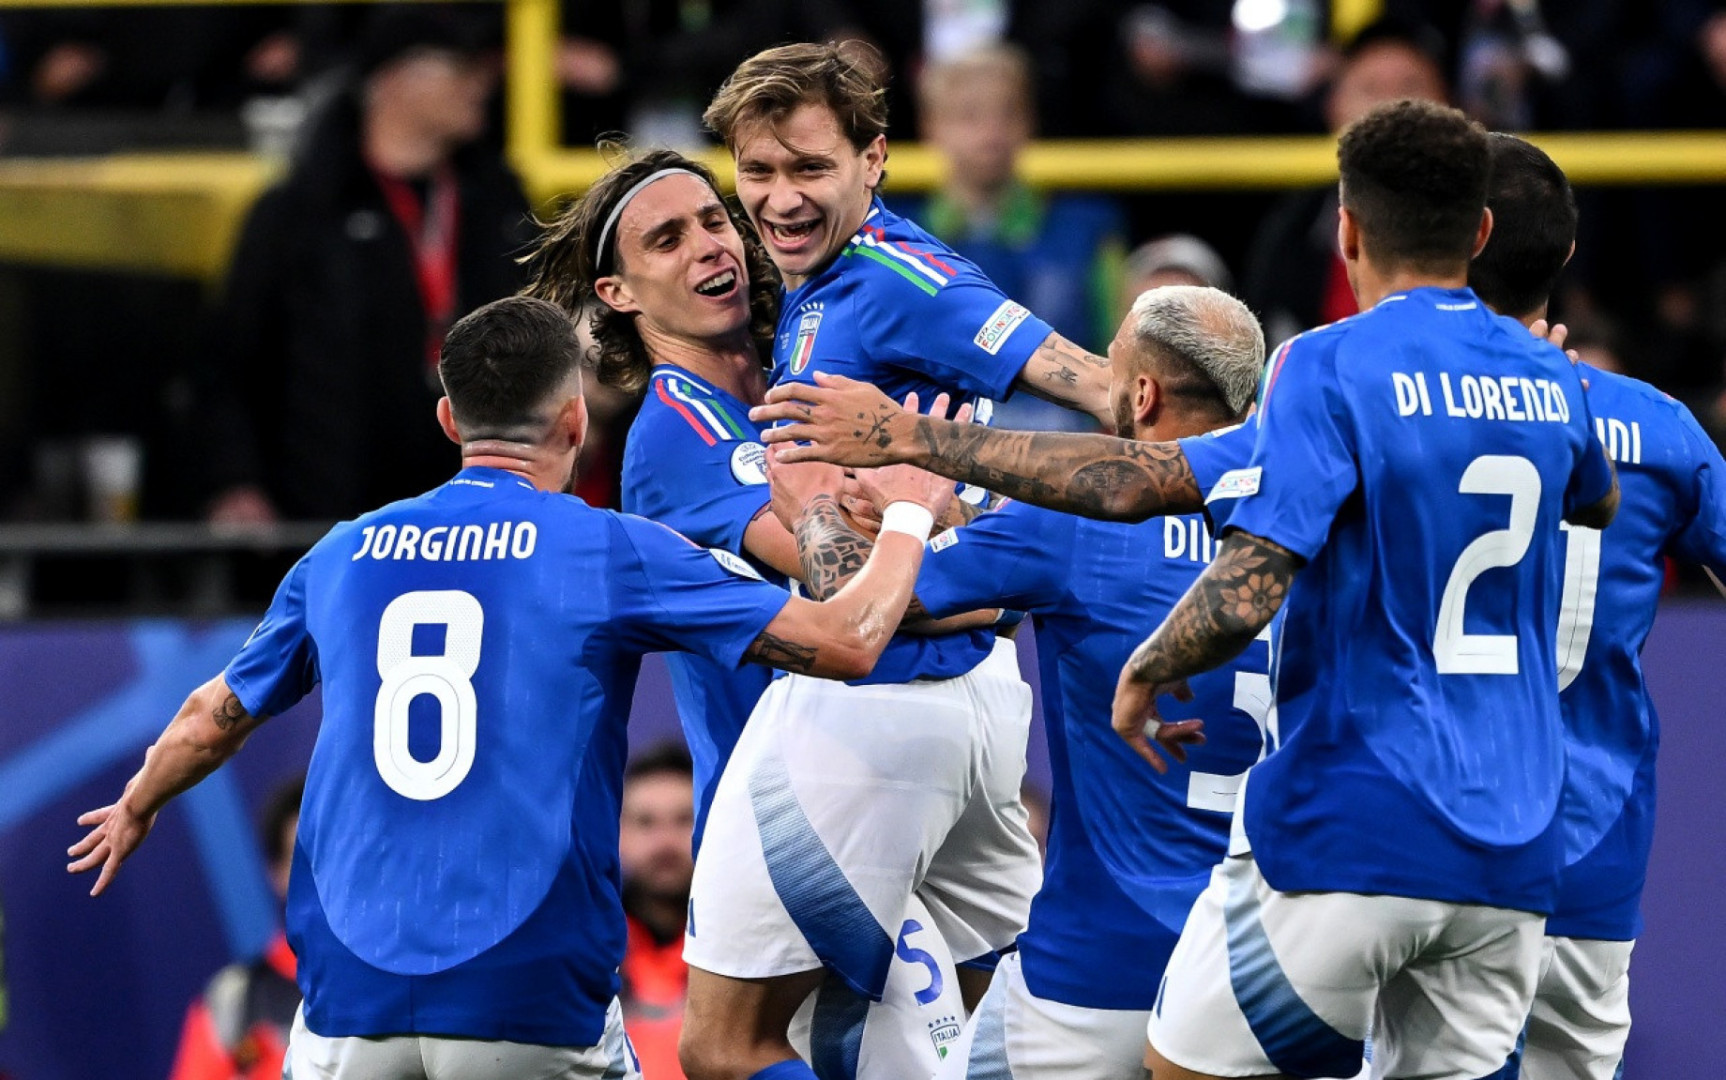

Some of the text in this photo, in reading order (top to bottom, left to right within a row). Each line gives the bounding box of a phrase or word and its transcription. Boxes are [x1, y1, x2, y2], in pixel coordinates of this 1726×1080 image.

[1392, 371, 1570, 424] DI LORENZO
[352, 521, 537, 562] JORGINHO
[1433, 454, 1542, 674] 2
[373, 590, 484, 801] 8
[897, 919, 943, 1006] 5
[933, 1028, 958, 1043] ITALIA
